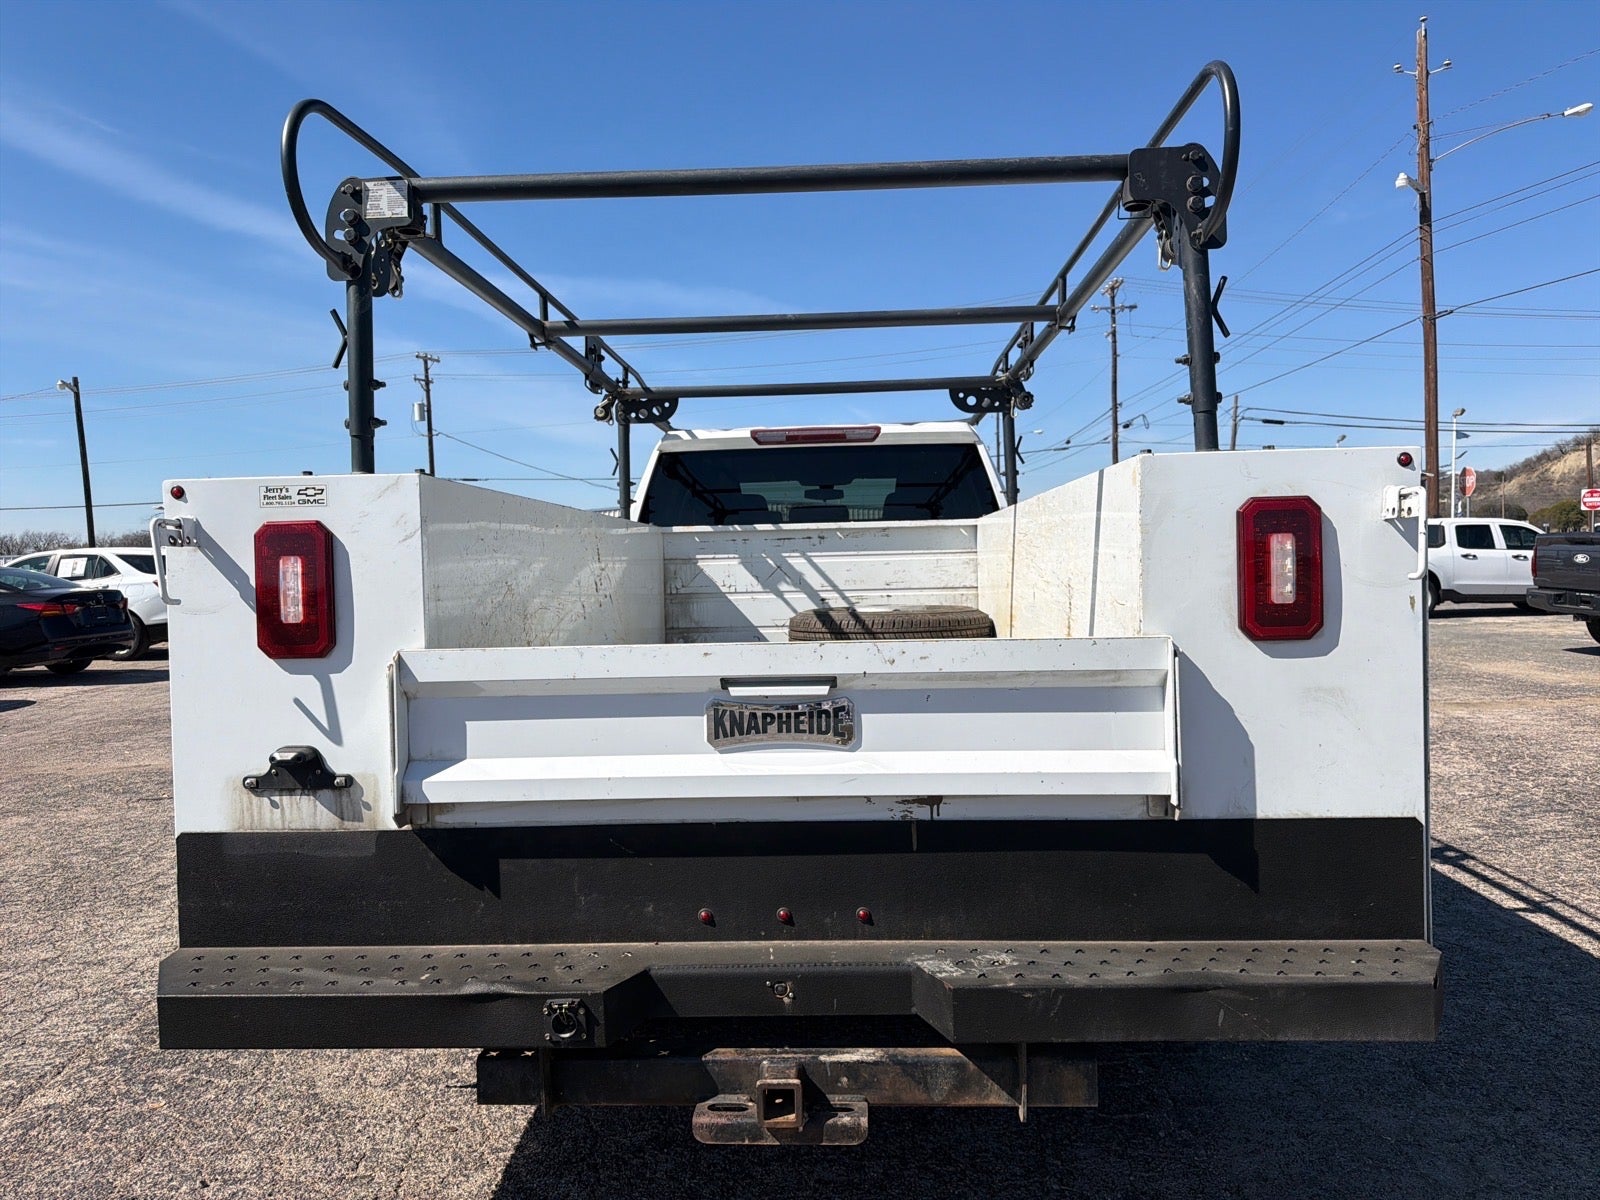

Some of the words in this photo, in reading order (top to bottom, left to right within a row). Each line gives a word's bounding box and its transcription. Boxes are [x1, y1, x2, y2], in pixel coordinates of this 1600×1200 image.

[1459, 476, 1475, 487] STOP
[264, 486, 289, 494] Jerry's
[713, 705, 846, 740] KNAPHEIDE
